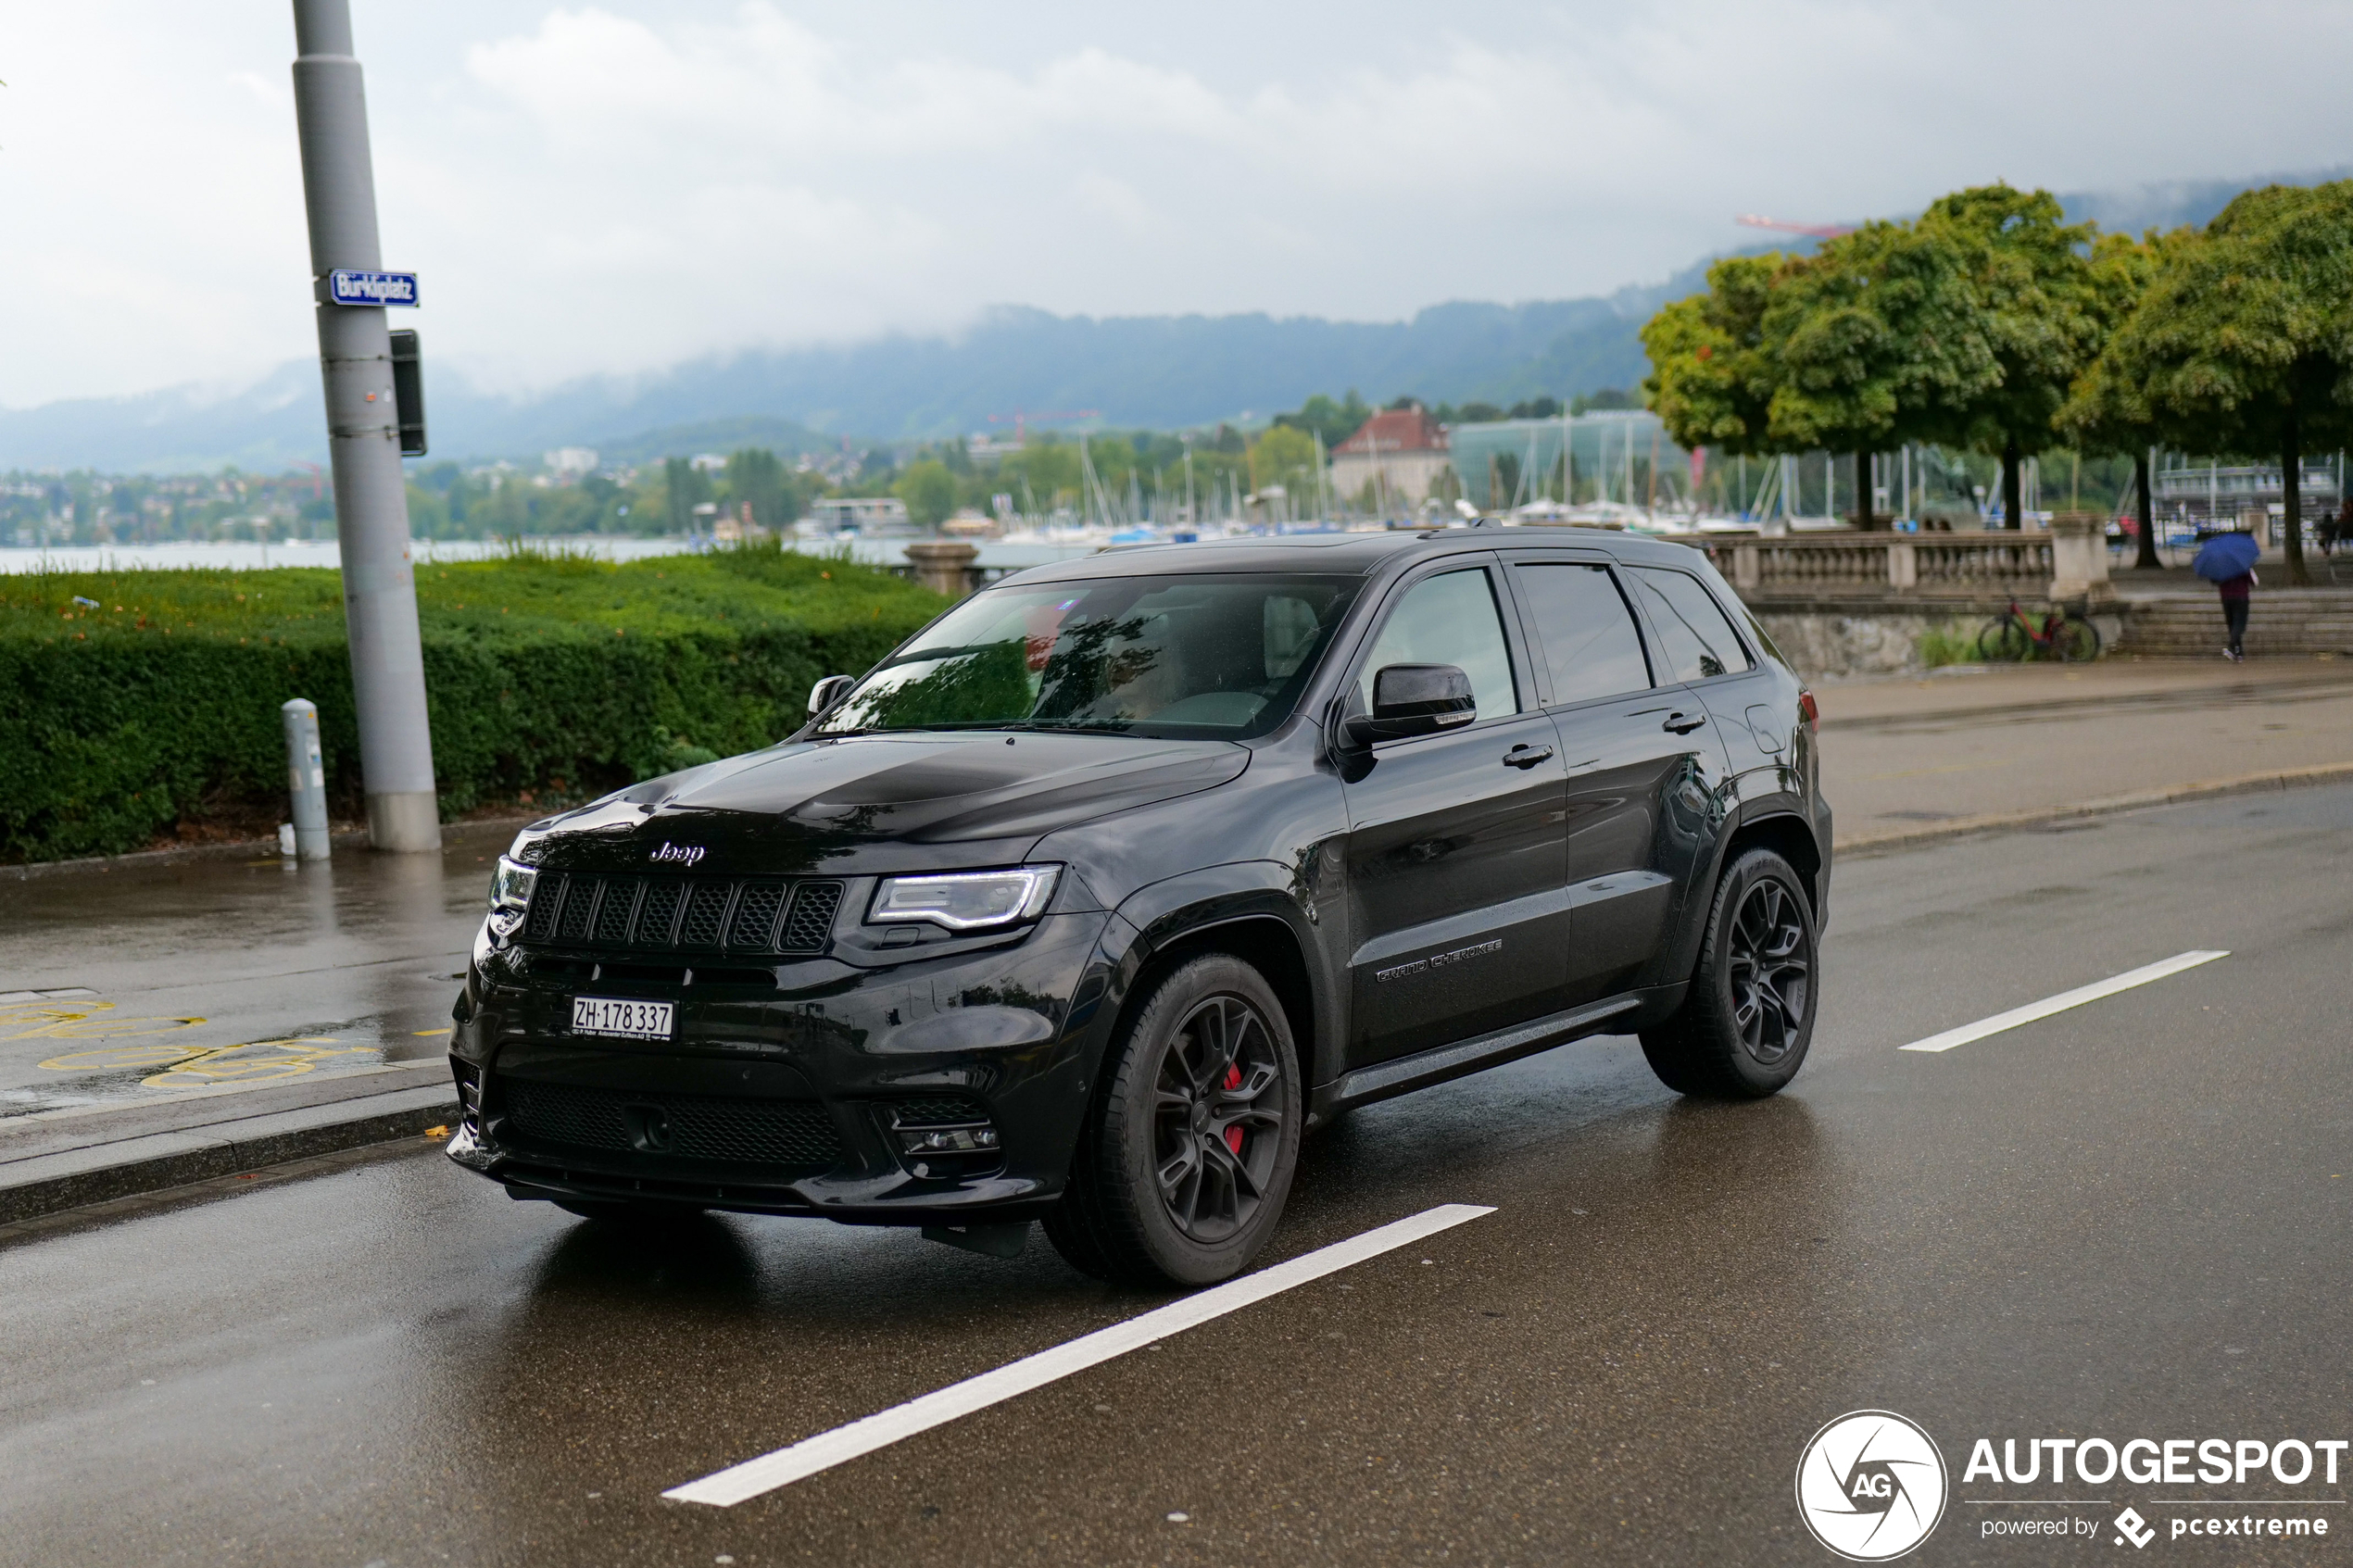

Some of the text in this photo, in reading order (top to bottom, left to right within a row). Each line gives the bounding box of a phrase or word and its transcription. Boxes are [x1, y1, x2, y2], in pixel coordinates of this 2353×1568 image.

[336, 272, 413, 304] Bürkliplatz
[648, 840, 705, 867] Jeep
[1376, 939, 1502, 982] GRAND CHEROKEE
